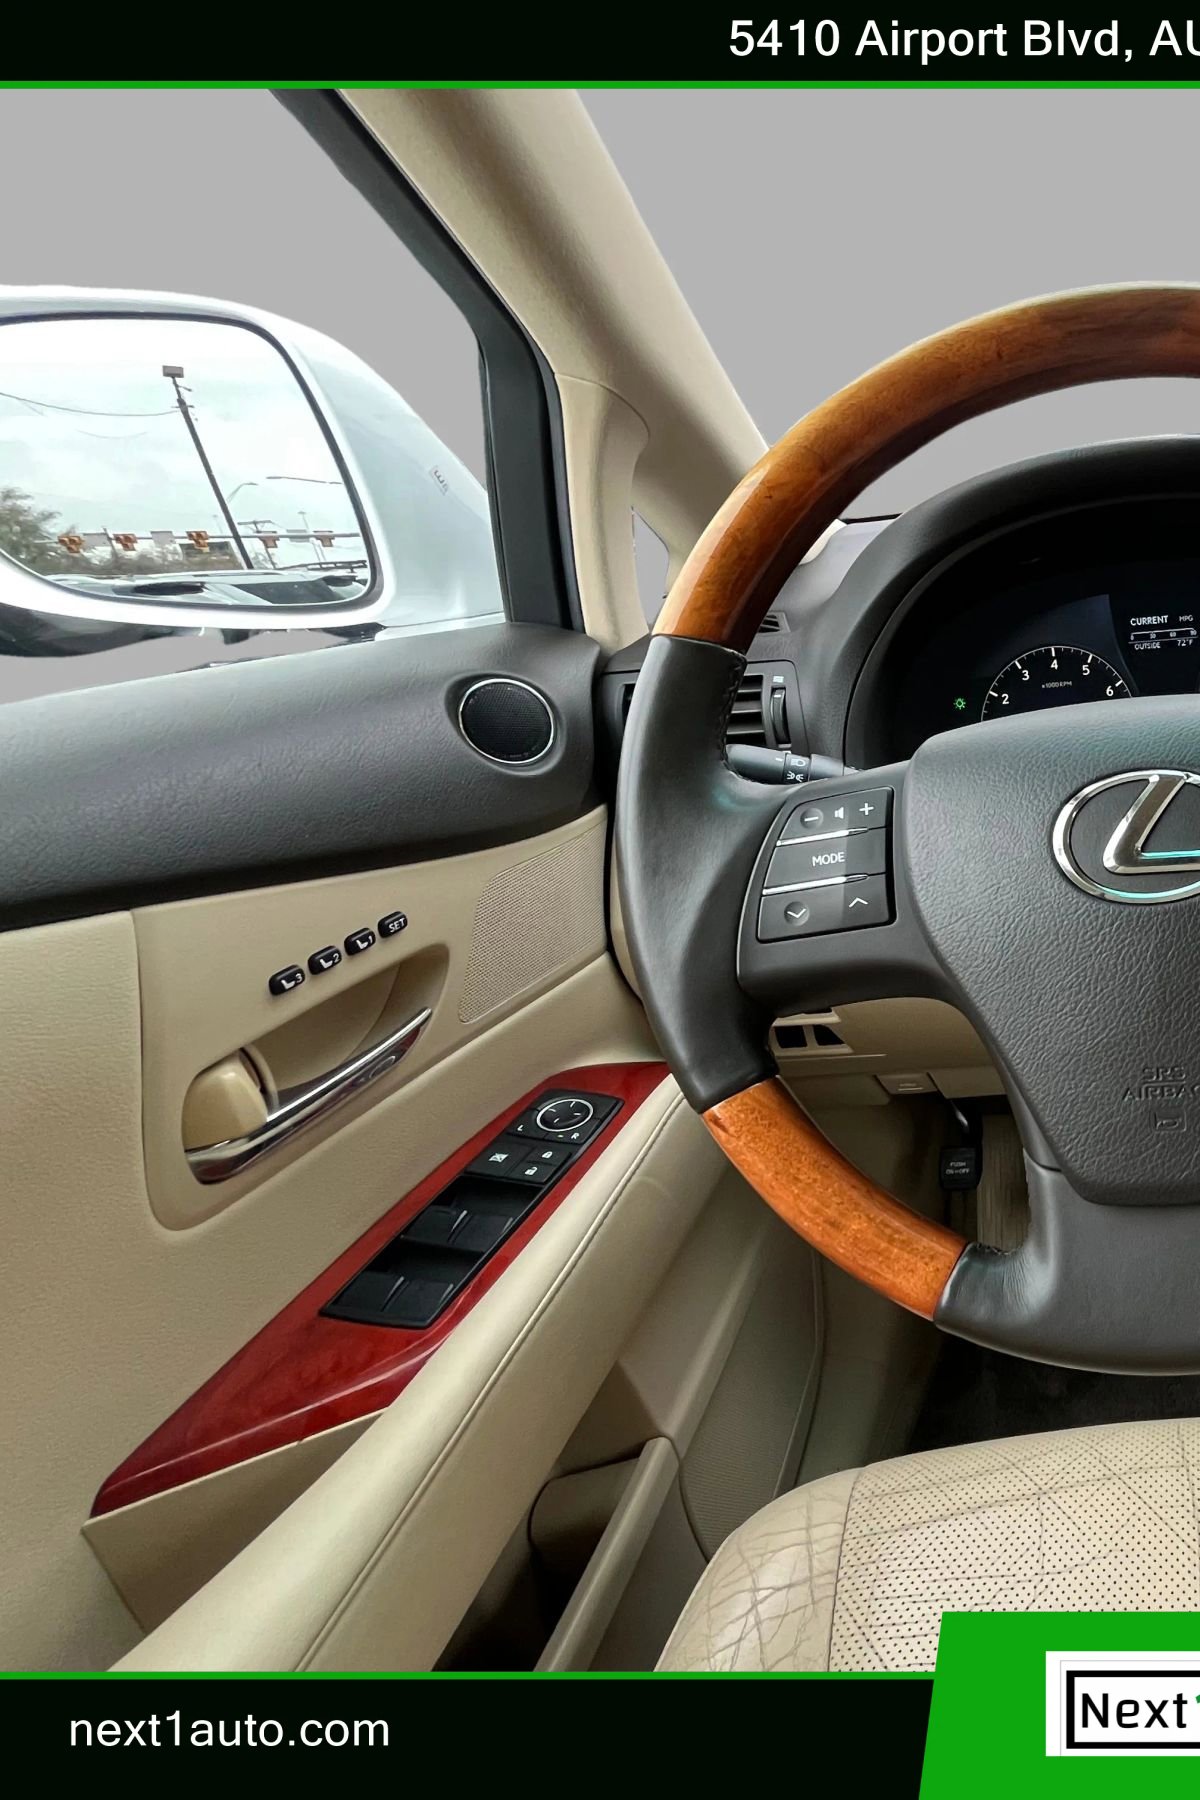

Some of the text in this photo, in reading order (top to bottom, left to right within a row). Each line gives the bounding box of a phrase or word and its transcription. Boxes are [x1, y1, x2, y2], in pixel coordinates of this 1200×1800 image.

[1130, 614, 1194, 626] CURRENT MPG
[1134, 641, 1161, 650] OUTSIDE
[1050, 659, 1059, 670] 4
[1021, 670, 1030, 681] 3
[1082, 665, 1090, 676] 5
[1106, 686, 1114, 697] 6
[1001, 693, 1010, 705] 2
[812, 851, 845, 867] MODE
[388, 917, 405, 933] SET
